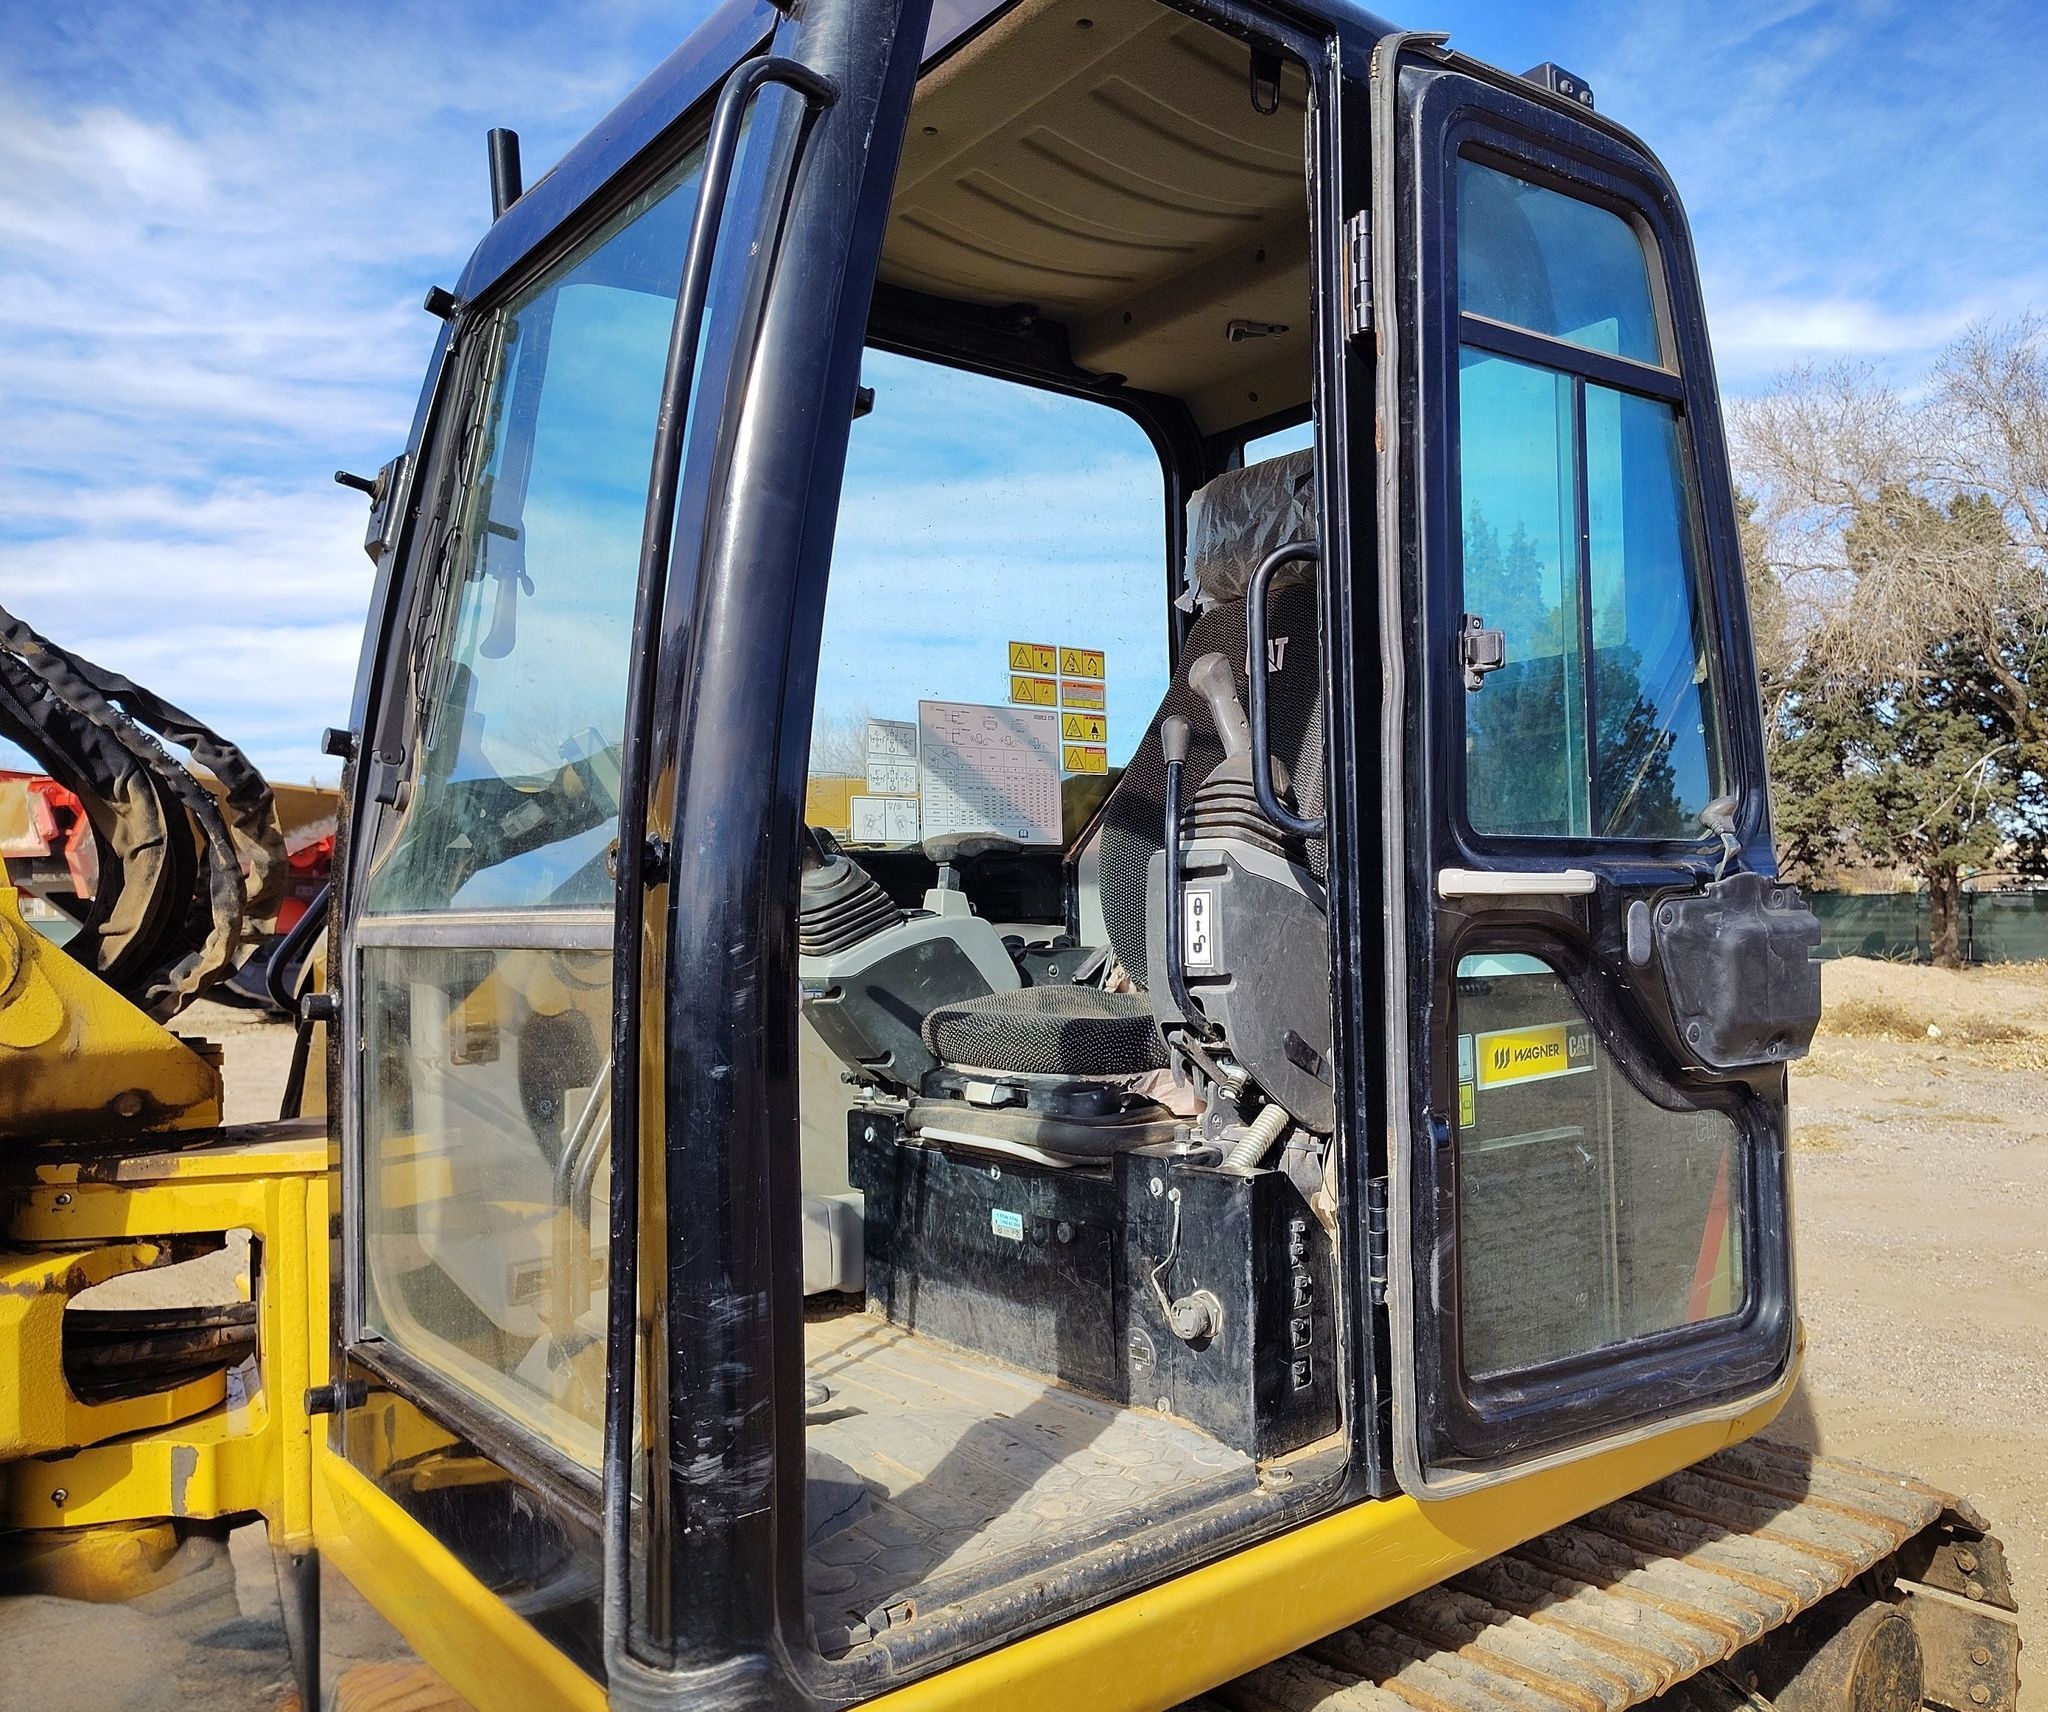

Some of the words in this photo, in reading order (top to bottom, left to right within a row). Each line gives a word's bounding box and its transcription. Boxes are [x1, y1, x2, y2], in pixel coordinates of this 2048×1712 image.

[1245, 636, 1289, 675] AT
[1513, 1043, 1560, 1062] WAGNER
[1568, 1033, 1591, 1058] CAT
